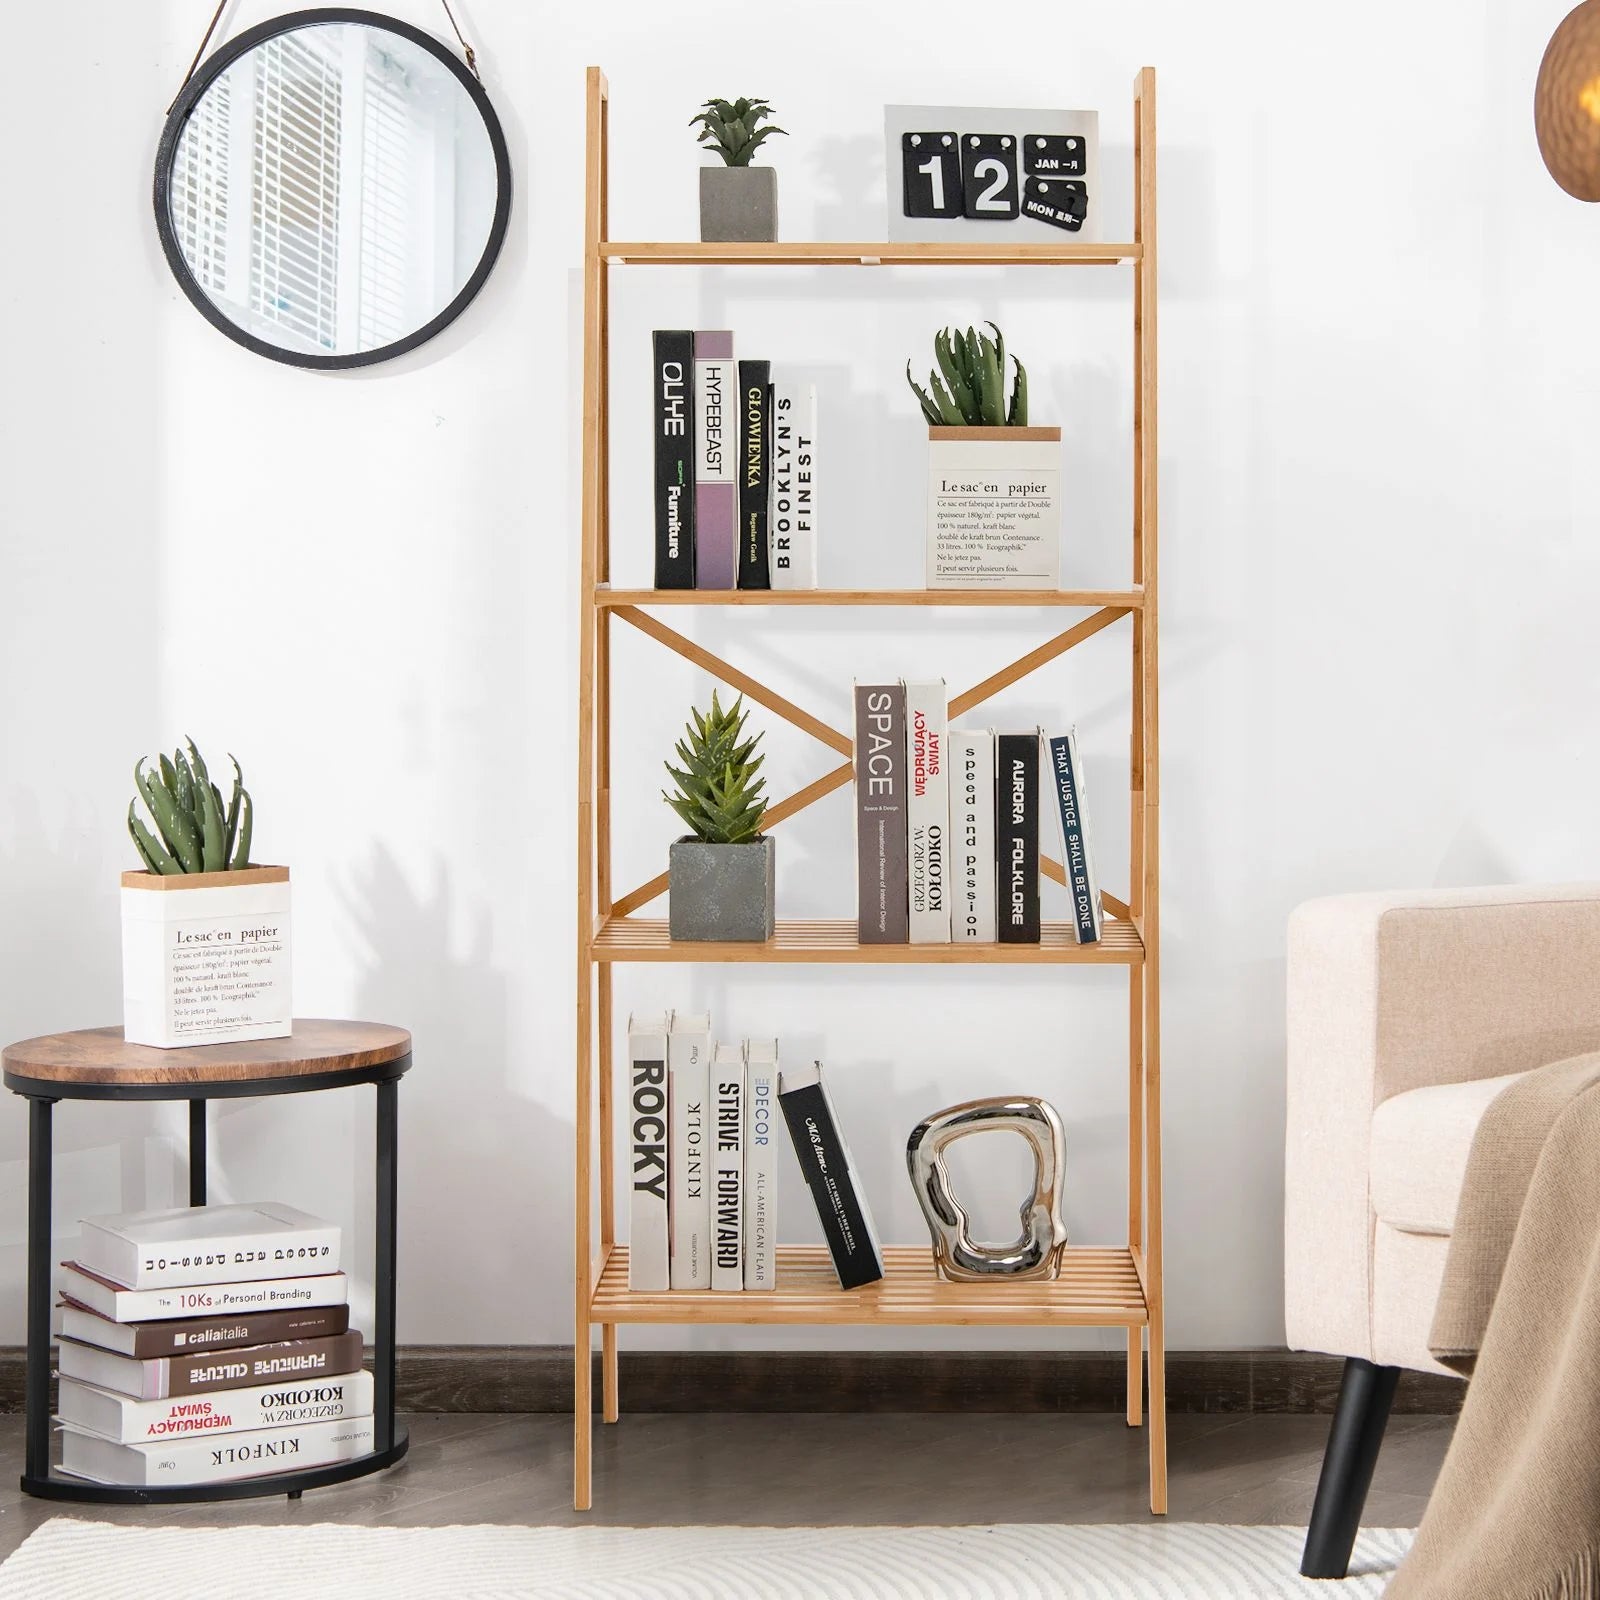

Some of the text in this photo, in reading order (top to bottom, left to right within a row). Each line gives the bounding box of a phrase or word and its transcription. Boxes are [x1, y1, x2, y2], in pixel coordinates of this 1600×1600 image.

[1035, 160, 1058, 170] JAN
[1027, 201, 1080, 224] MON 星期一
[706, 367, 722, 474] HYPEBEAST
[748, 388, 762, 488] GŁOWIENKA
[798, 437, 811, 531] FINEST
[942, 480, 958, 492] Le
[984, 484, 998, 492] en
[1008, 482, 1047, 496] papier
[1028, 500, 1051, 508] Double
[668, 486, 682, 558] Furniture
[977, 565, 1004, 573] plusieurs
[867, 692, 892, 796] SPACE
[914, 710, 927, 796] WĘDRUJĄCY
[928, 732, 939, 775] ŚWIAT
[966, 748, 976, 936] speed and passion
[1012, 760, 1025, 925] AURORA FOLKLORE
[1054, 744, 1091, 928] THAT JUSTICE SHALL BE DONE
[914, 825, 924, 912] GRZEGORZ W.
[928, 825, 942, 912] KOŁODKO
[177, 931, 192, 943] Le
[217, 932, 231, 940] en
[241, 925, 278, 942] papier
[633, 1060, 665, 1200] ROCKY
[755, 1086, 769, 1146] DECOR
[688, 1102, 701, 1199] KINFOLK
[717, 1082, 739, 1269] STRIVE FORWARD
[756, 1173, 764, 1281] ALL-AMERICAN FLAIR
[146, 1246, 329, 1270] speed and passion
[180, 1293, 212, 1308] 10Ks
[223, 1290, 266, 1304] Personal
[270, 1288, 312, 1300] Branding
[190, 1353, 325, 1384] FURNITURE CULTURE
[261, 1386, 343, 1408] KOŁODKO
[148, 1415, 232, 1434] WĘDRUJĄCY
[170, 1403, 212, 1417] ŚWIAT
[261, 1404, 344, 1423] GRZEGORZ W.
[212, 1438, 300, 1465] KINFOLK
